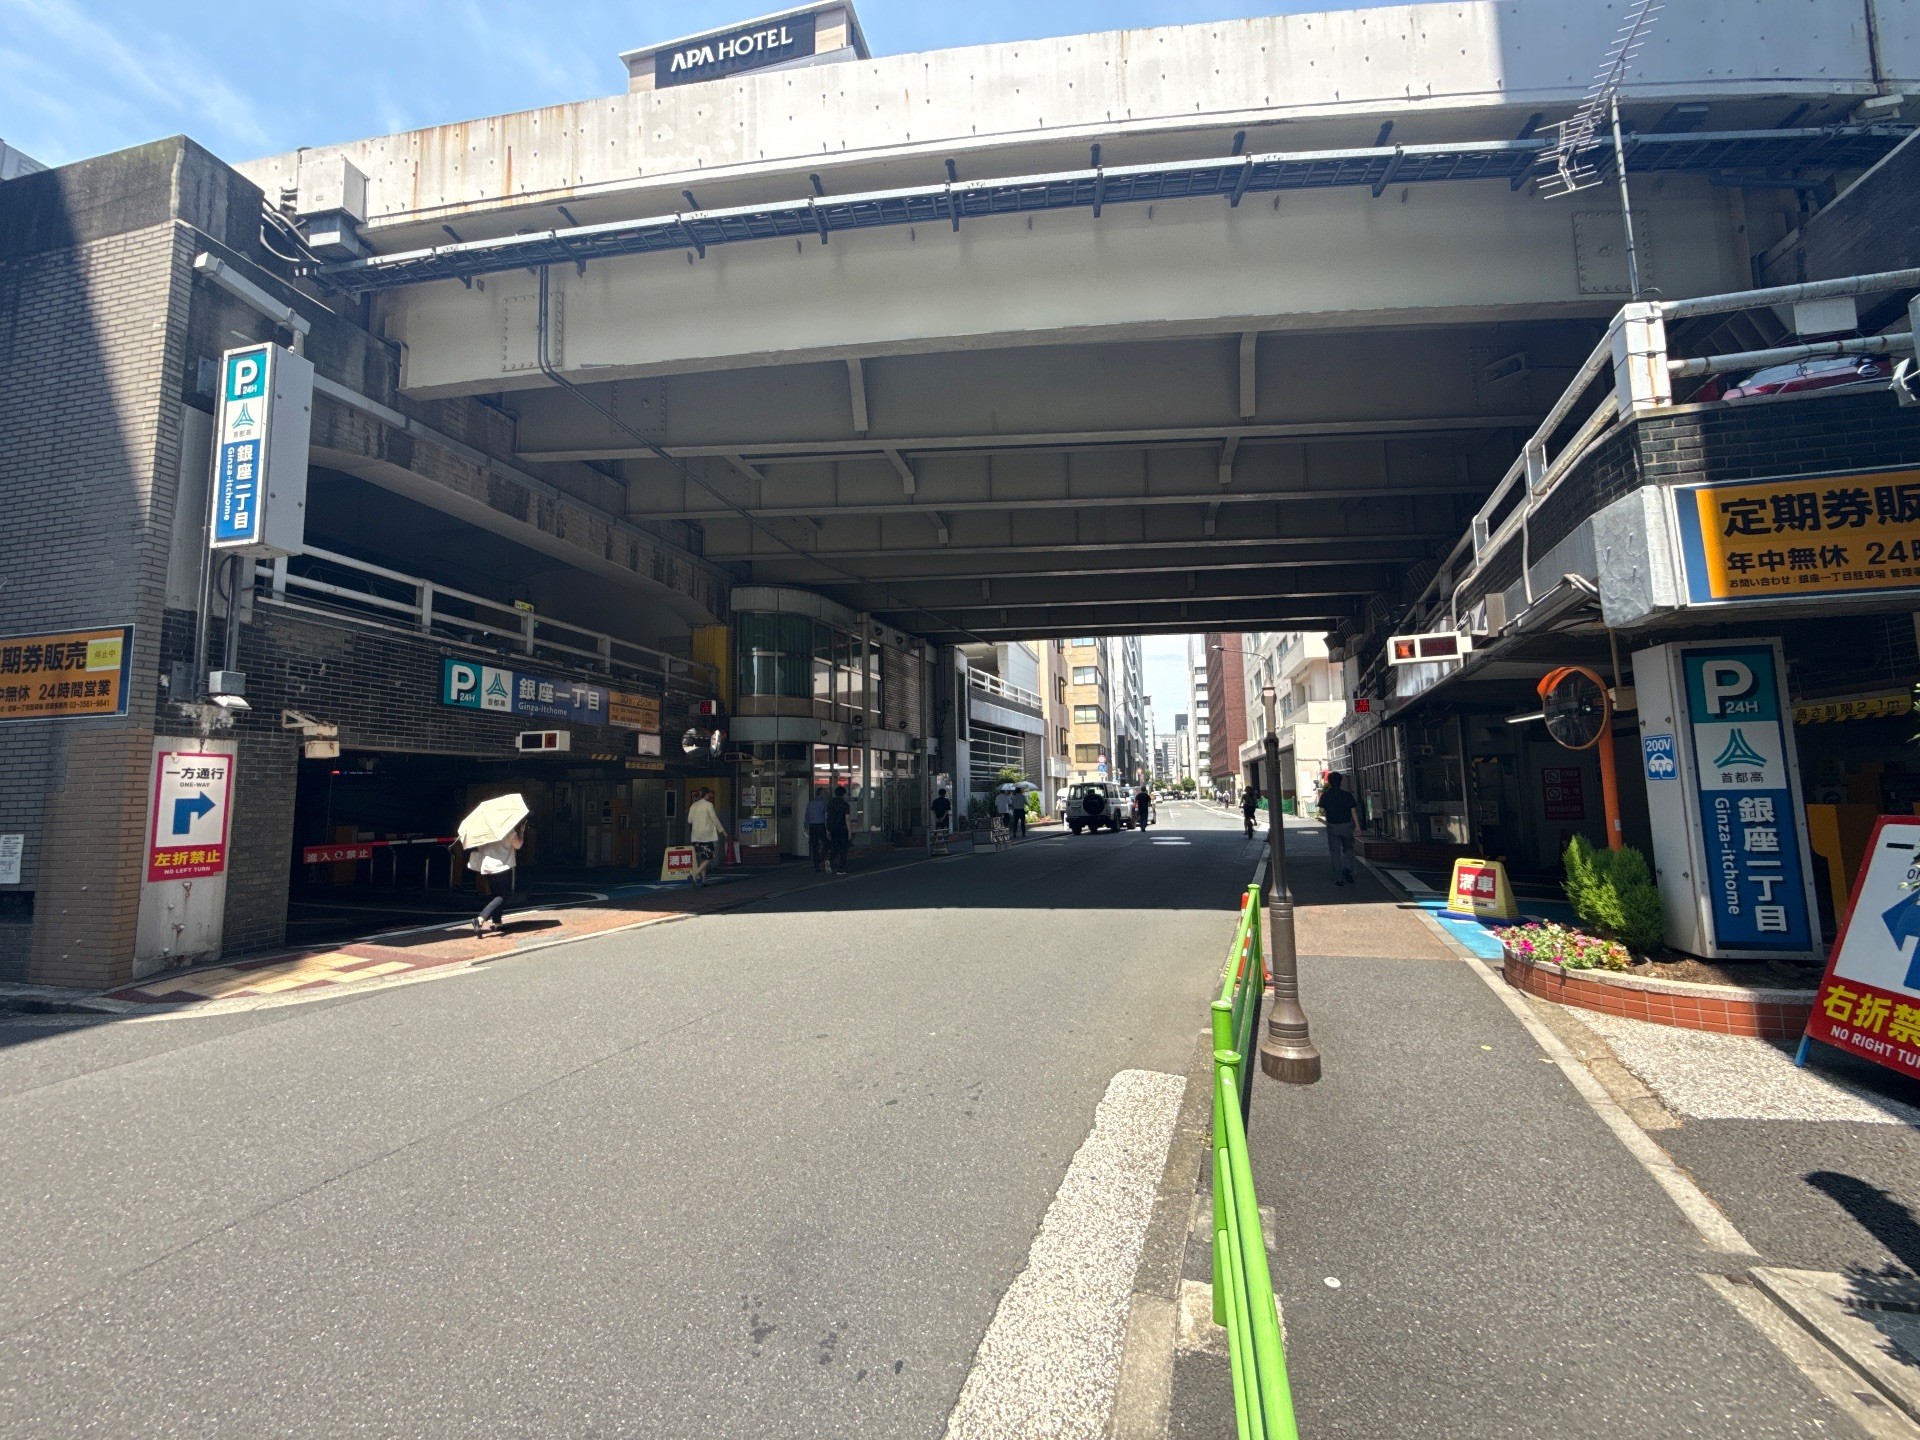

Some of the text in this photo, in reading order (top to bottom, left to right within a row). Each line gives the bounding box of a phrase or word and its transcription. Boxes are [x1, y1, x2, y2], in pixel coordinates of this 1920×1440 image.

[670, 26, 793, 72] APA HOTEL
[234, 359, 258, 396] P
[243, 385, 257, 394] 24H
[223, 447, 235, 521] Ginza-itchome
[234, 445, 254, 531] 銀座一丁目
[1720, 484, 1920, 537] 定期券販
[1726, 544, 1849, 574] 年中無休
[39, 679, 111, 701] 24時間営業
[450, 664, 475, 700] P
[519, 677, 600, 711] 銀座一丁目
[1702, 660, 1753, 715] P
[459, 693, 475, 703] 24H
[488, 698, 506, 707] 首都高
[518, 702, 568, 716] Ginza-itchome
[1725, 701, 1759, 714] 24H
[1646, 738, 1671, 752] 200V
[165, 767, 224, 780] 一方通行
[1720, 772, 1764, 784] 首都高
[154, 849, 221, 867] 左折禁止
[1714, 797, 1740, 915] Ginza-itchome
[1738, 797, 1788, 932] 銀座一丁目
[175, 867, 192, 875] LEFT
[1459, 873, 1494, 893] 満車
[1831, 1024, 1920, 1069] NO RIGHT TU
